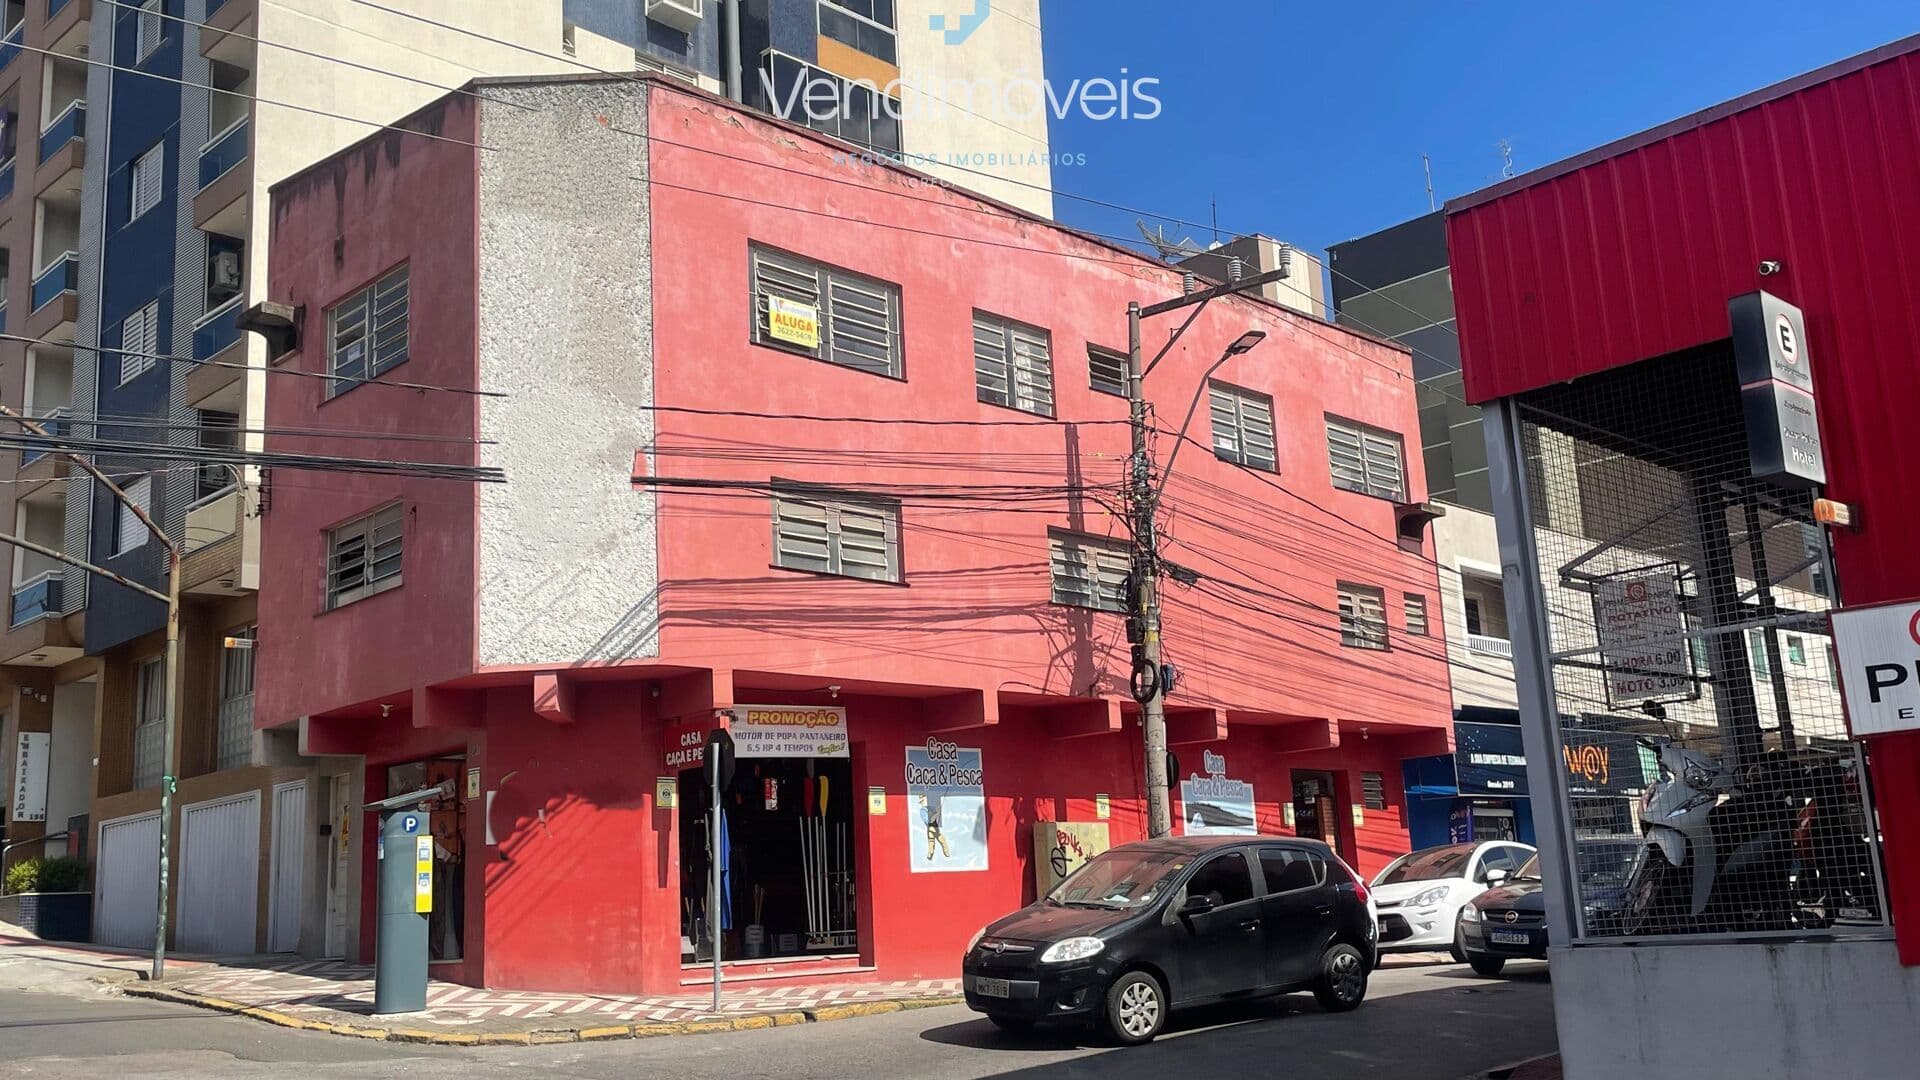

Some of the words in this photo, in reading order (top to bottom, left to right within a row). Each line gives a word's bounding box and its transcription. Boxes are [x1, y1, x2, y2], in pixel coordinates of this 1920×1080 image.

[775, 313, 813, 334] ALUGA
[1780, 325, 1792, 353] E
[1792, 446, 1816, 466] Hotel
[1609, 605, 1672, 623] ROTATIVO
[1623, 655, 1654, 668] HORA
[1616, 678, 1654, 695] MOTO
[1865, 659, 1920, 704] P
[747, 709, 839, 728] PROMOÇÃO
[681, 732, 702, 747] CASA
[735, 732, 762, 740] MOTOR
[765, 732, 774, 740] DE
[777, 732, 797, 740] POPA
[800, 732, 846, 741] PANTANEIRO
[666, 751, 685, 767] CAÇA
[687, 750, 691, 761] E
[693, 748, 704, 760] PE
[763, 744, 774, 752] HP
[776, 744, 780, 752] 4
[784, 744, 814, 752] TEMPOS
[928, 737, 957, 760] Casa
[1204, 750, 1225, 774] Casa
[18, 734, 29, 818] EMBAIXADOR
[906, 762, 937, 790] Caça
[939, 764, 947, 785] &
[949, 764, 983, 786] Pesca
[1191, 773, 1212, 799] Caça
[1219, 775, 1243, 799] Pesca
[406, 818, 416, 831] P
